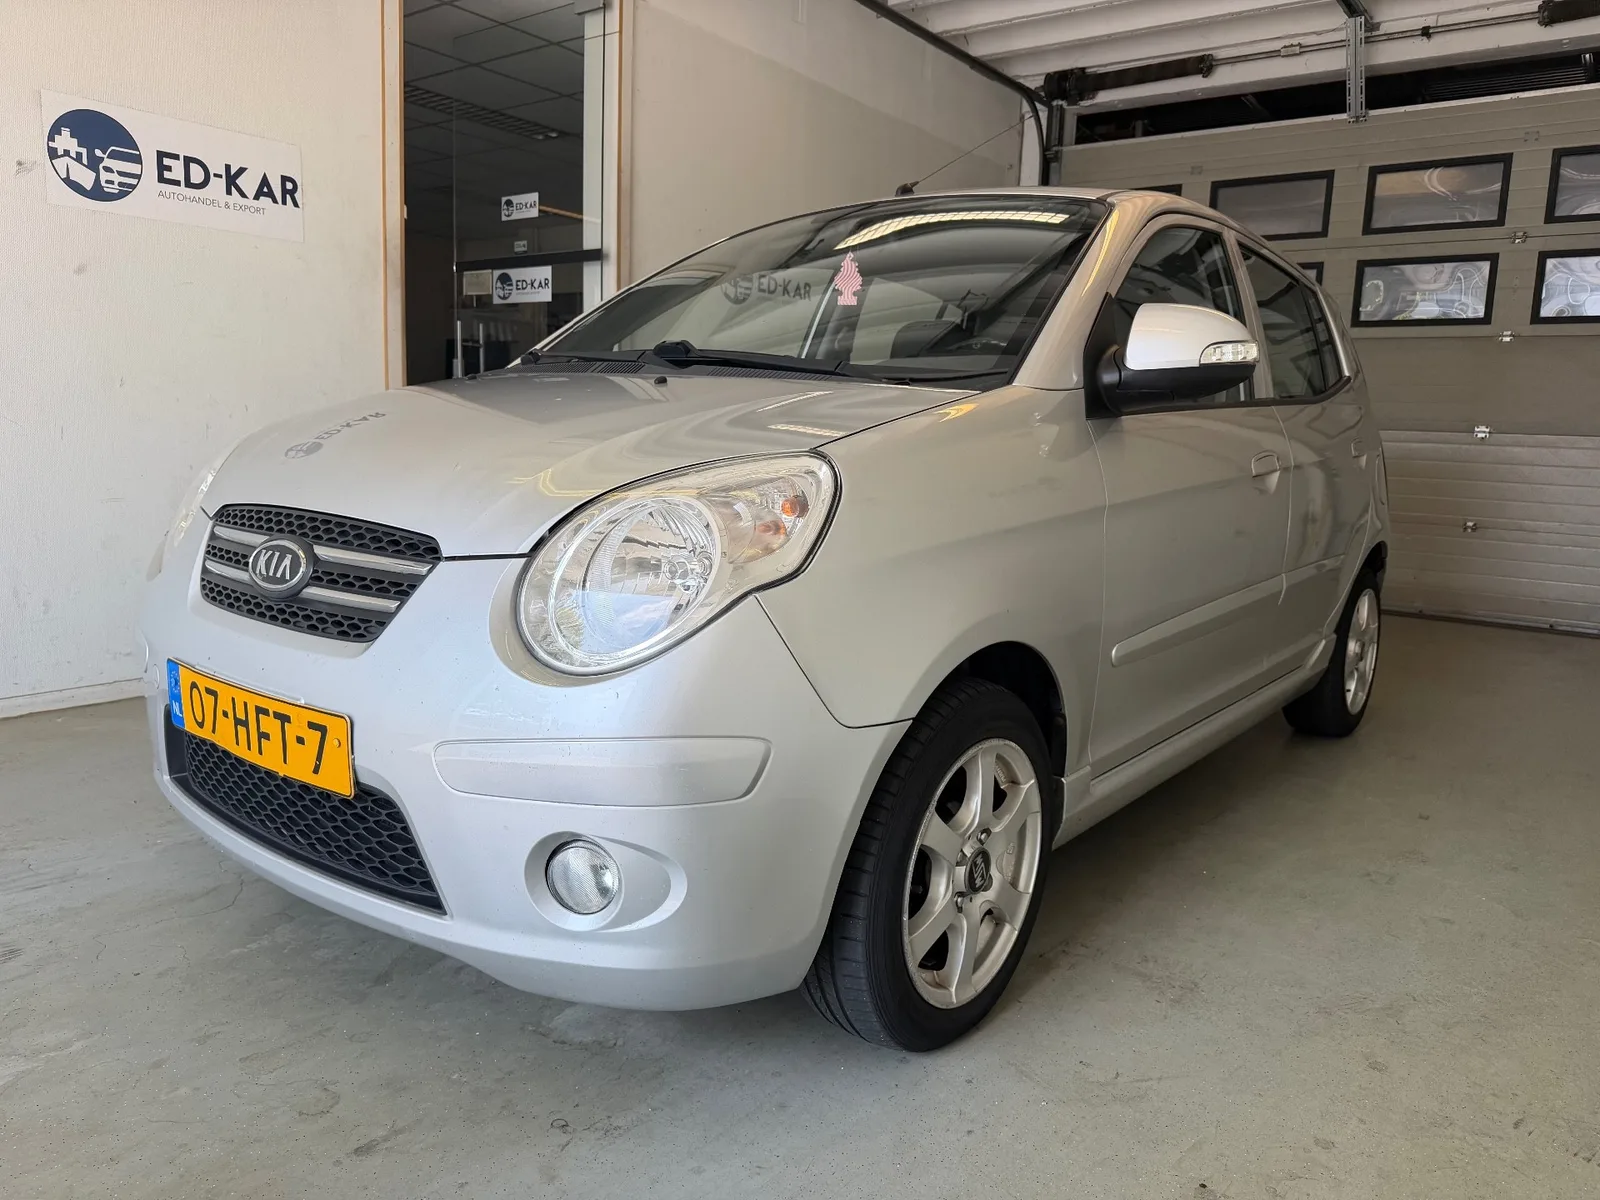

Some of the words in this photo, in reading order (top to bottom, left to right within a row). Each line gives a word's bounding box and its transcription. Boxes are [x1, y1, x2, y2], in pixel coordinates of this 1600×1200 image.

[156, 149, 300, 209] ED-KAR
[158, 190, 222, 209] AUTOHANDEL
[224, 201, 231, 210] &
[233, 203, 266, 216] EXPORT
[515, 201, 537, 211] ED-KAR
[515, 278, 550, 291] ED-KAR
[758, 274, 811, 301] ED-KAR
[256, 549, 292, 580] KIA
[172, 699, 183, 718] NL
[189, 680, 328, 775] 07-HFT-7
